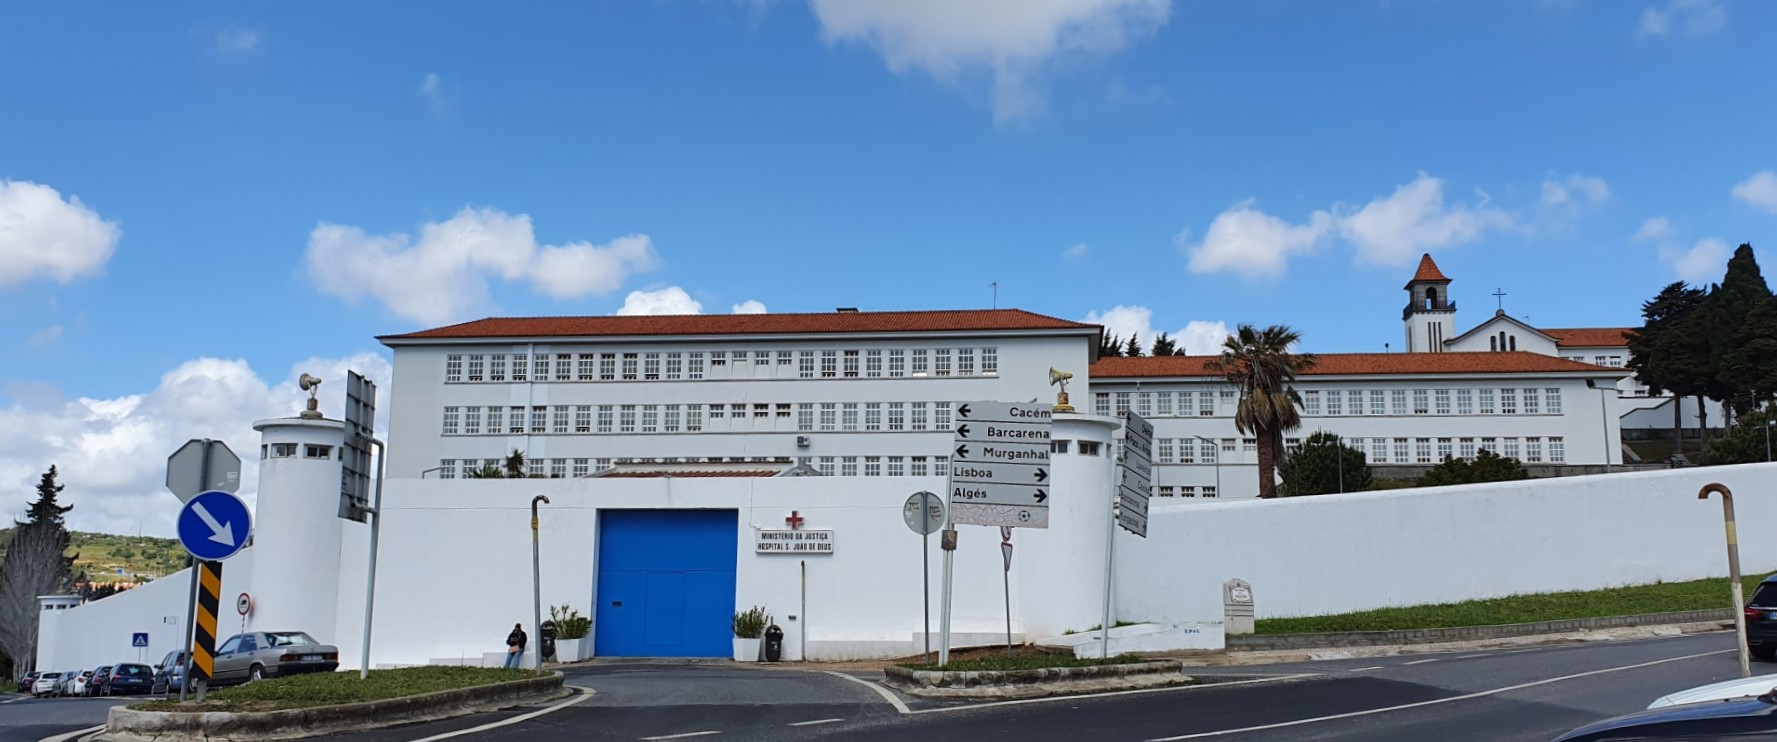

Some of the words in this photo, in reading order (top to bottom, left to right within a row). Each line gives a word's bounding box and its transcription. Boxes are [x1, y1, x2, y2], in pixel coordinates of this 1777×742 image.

[1010, 407, 1051, 418] Cacém
[987, 427, 1050, 439] Barcarena
[983, 447, 1050, 460] Murganhal
[953, 467, 993, 478] Lisboa
[953, 487, 987, 500] Algés
[796, 532, 802, 540] DA
[805, 532, 828, 542] JUSTIÇA
[758, 543, 783, 551] HOSPITAL
[809, 543, 815, 551] DE
[817, 543, 831, 551] DEUS
